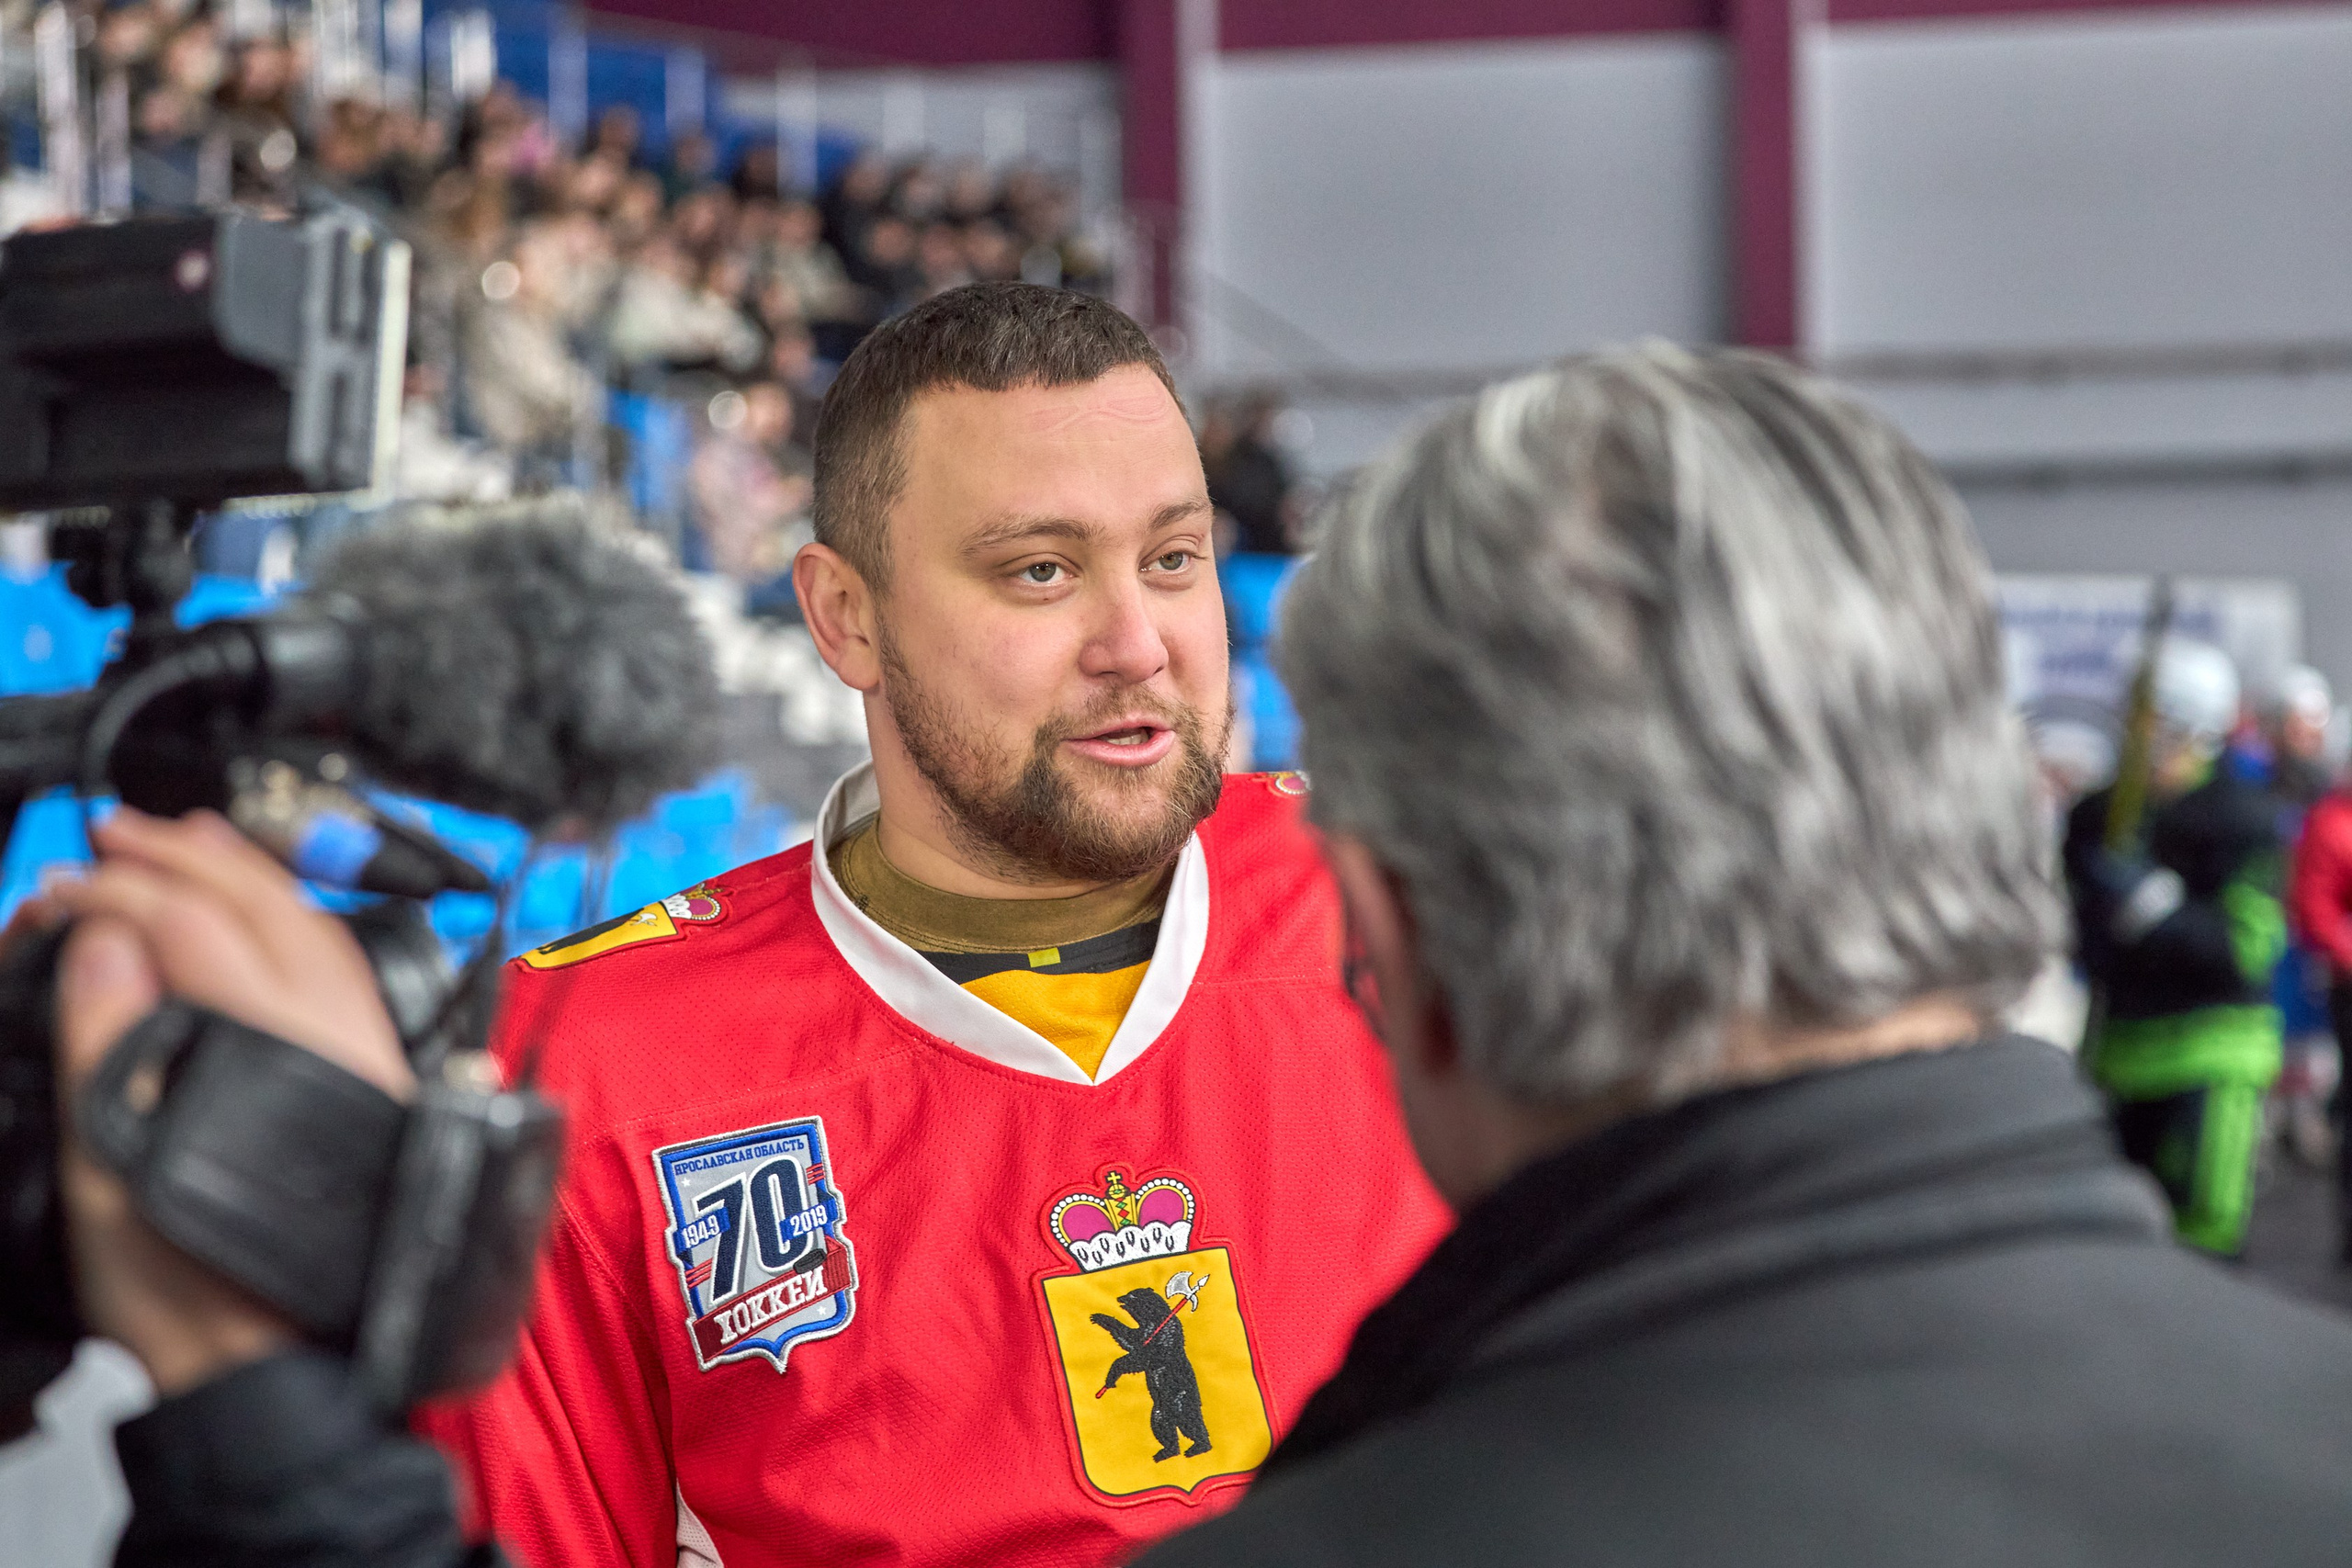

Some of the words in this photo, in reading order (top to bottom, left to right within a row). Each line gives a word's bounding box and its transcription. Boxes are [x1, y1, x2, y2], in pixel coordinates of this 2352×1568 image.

[674, 1149, 753, 1176] ЯРОСЛАВСКАЯ
[754, 1138, 805, 1158] ОБЛАСТЬ
[682, 1214, 720, 1248] 1949
[691, 1155, 814, 1307] 70
[789, 1204, 828, 1236] 2019
